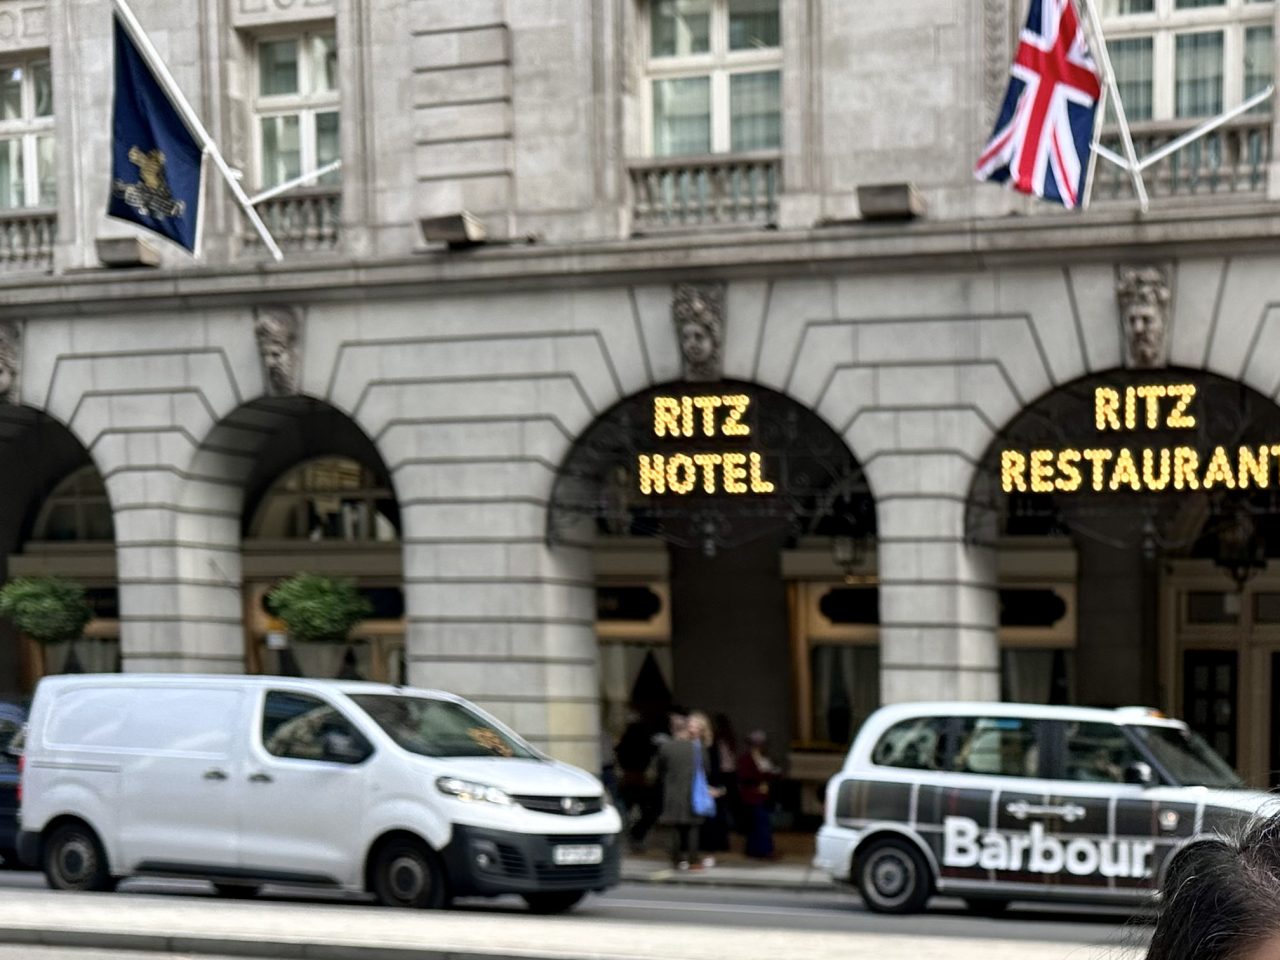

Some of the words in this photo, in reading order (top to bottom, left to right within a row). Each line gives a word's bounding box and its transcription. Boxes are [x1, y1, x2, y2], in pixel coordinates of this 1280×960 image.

[654, 394, 750, 437] RITZ
[1095, 384, 1196, 431] RITZ
[638, 451, 775, 495] HOTEL
[943, 815, 1154, 878] Barbour
